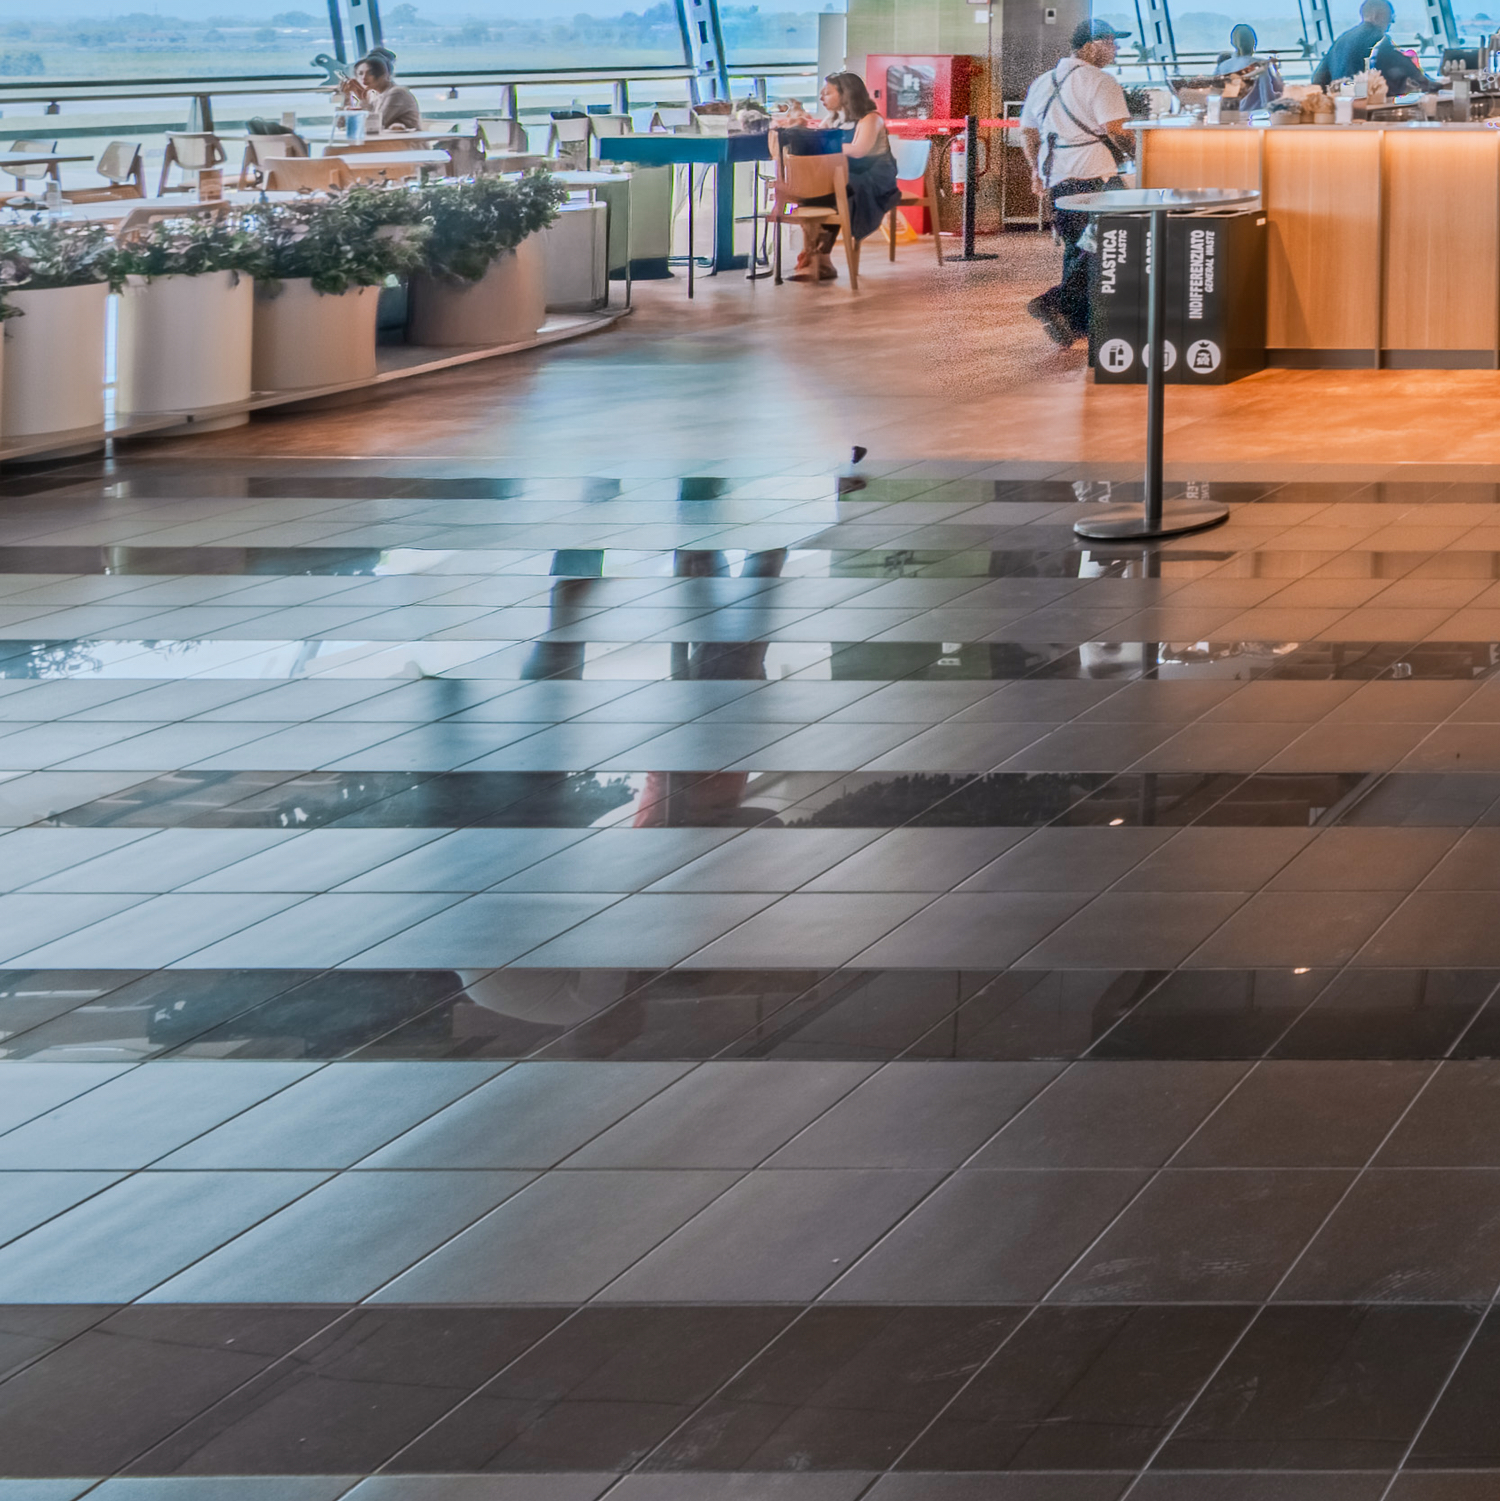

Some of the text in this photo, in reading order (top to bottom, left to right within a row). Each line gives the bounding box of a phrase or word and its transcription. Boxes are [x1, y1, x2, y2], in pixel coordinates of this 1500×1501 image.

[1101, 230, 1117, 293] PLASTICA
[1118, 229, 1127, 264] PLASTIC
[1189, 230, 1205, 319] INDIFFERENZIATO
[1205, 258, 1214, 293] GENERAL
